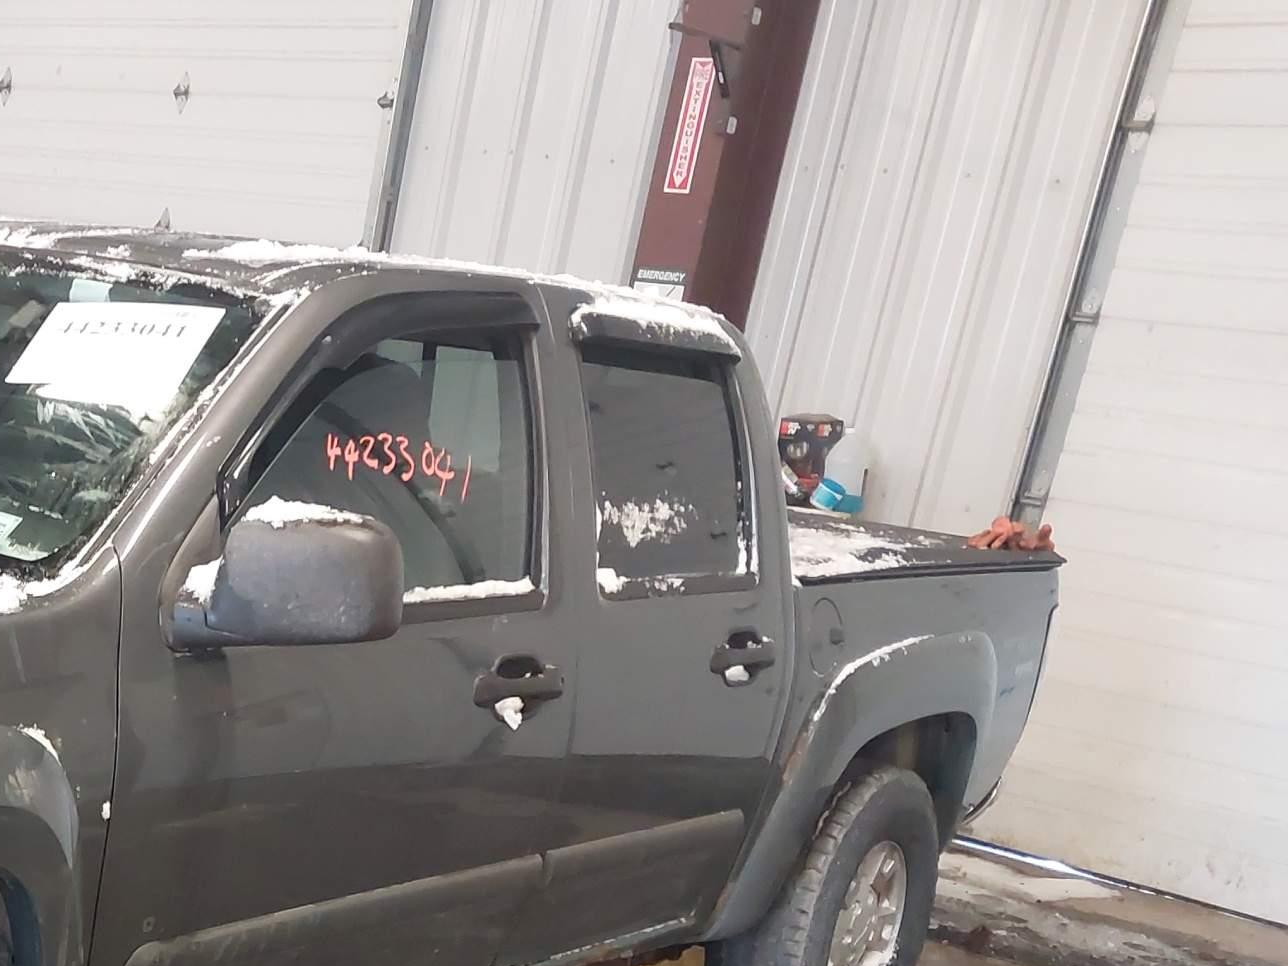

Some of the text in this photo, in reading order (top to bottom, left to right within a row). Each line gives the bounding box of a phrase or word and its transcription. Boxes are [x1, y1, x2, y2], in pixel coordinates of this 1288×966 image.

[675, 81, 703, 177] EXTINGUISHER
[637, 269, 686, 282] EMERGENCY
[327, 433, 472, 505] 44233041
